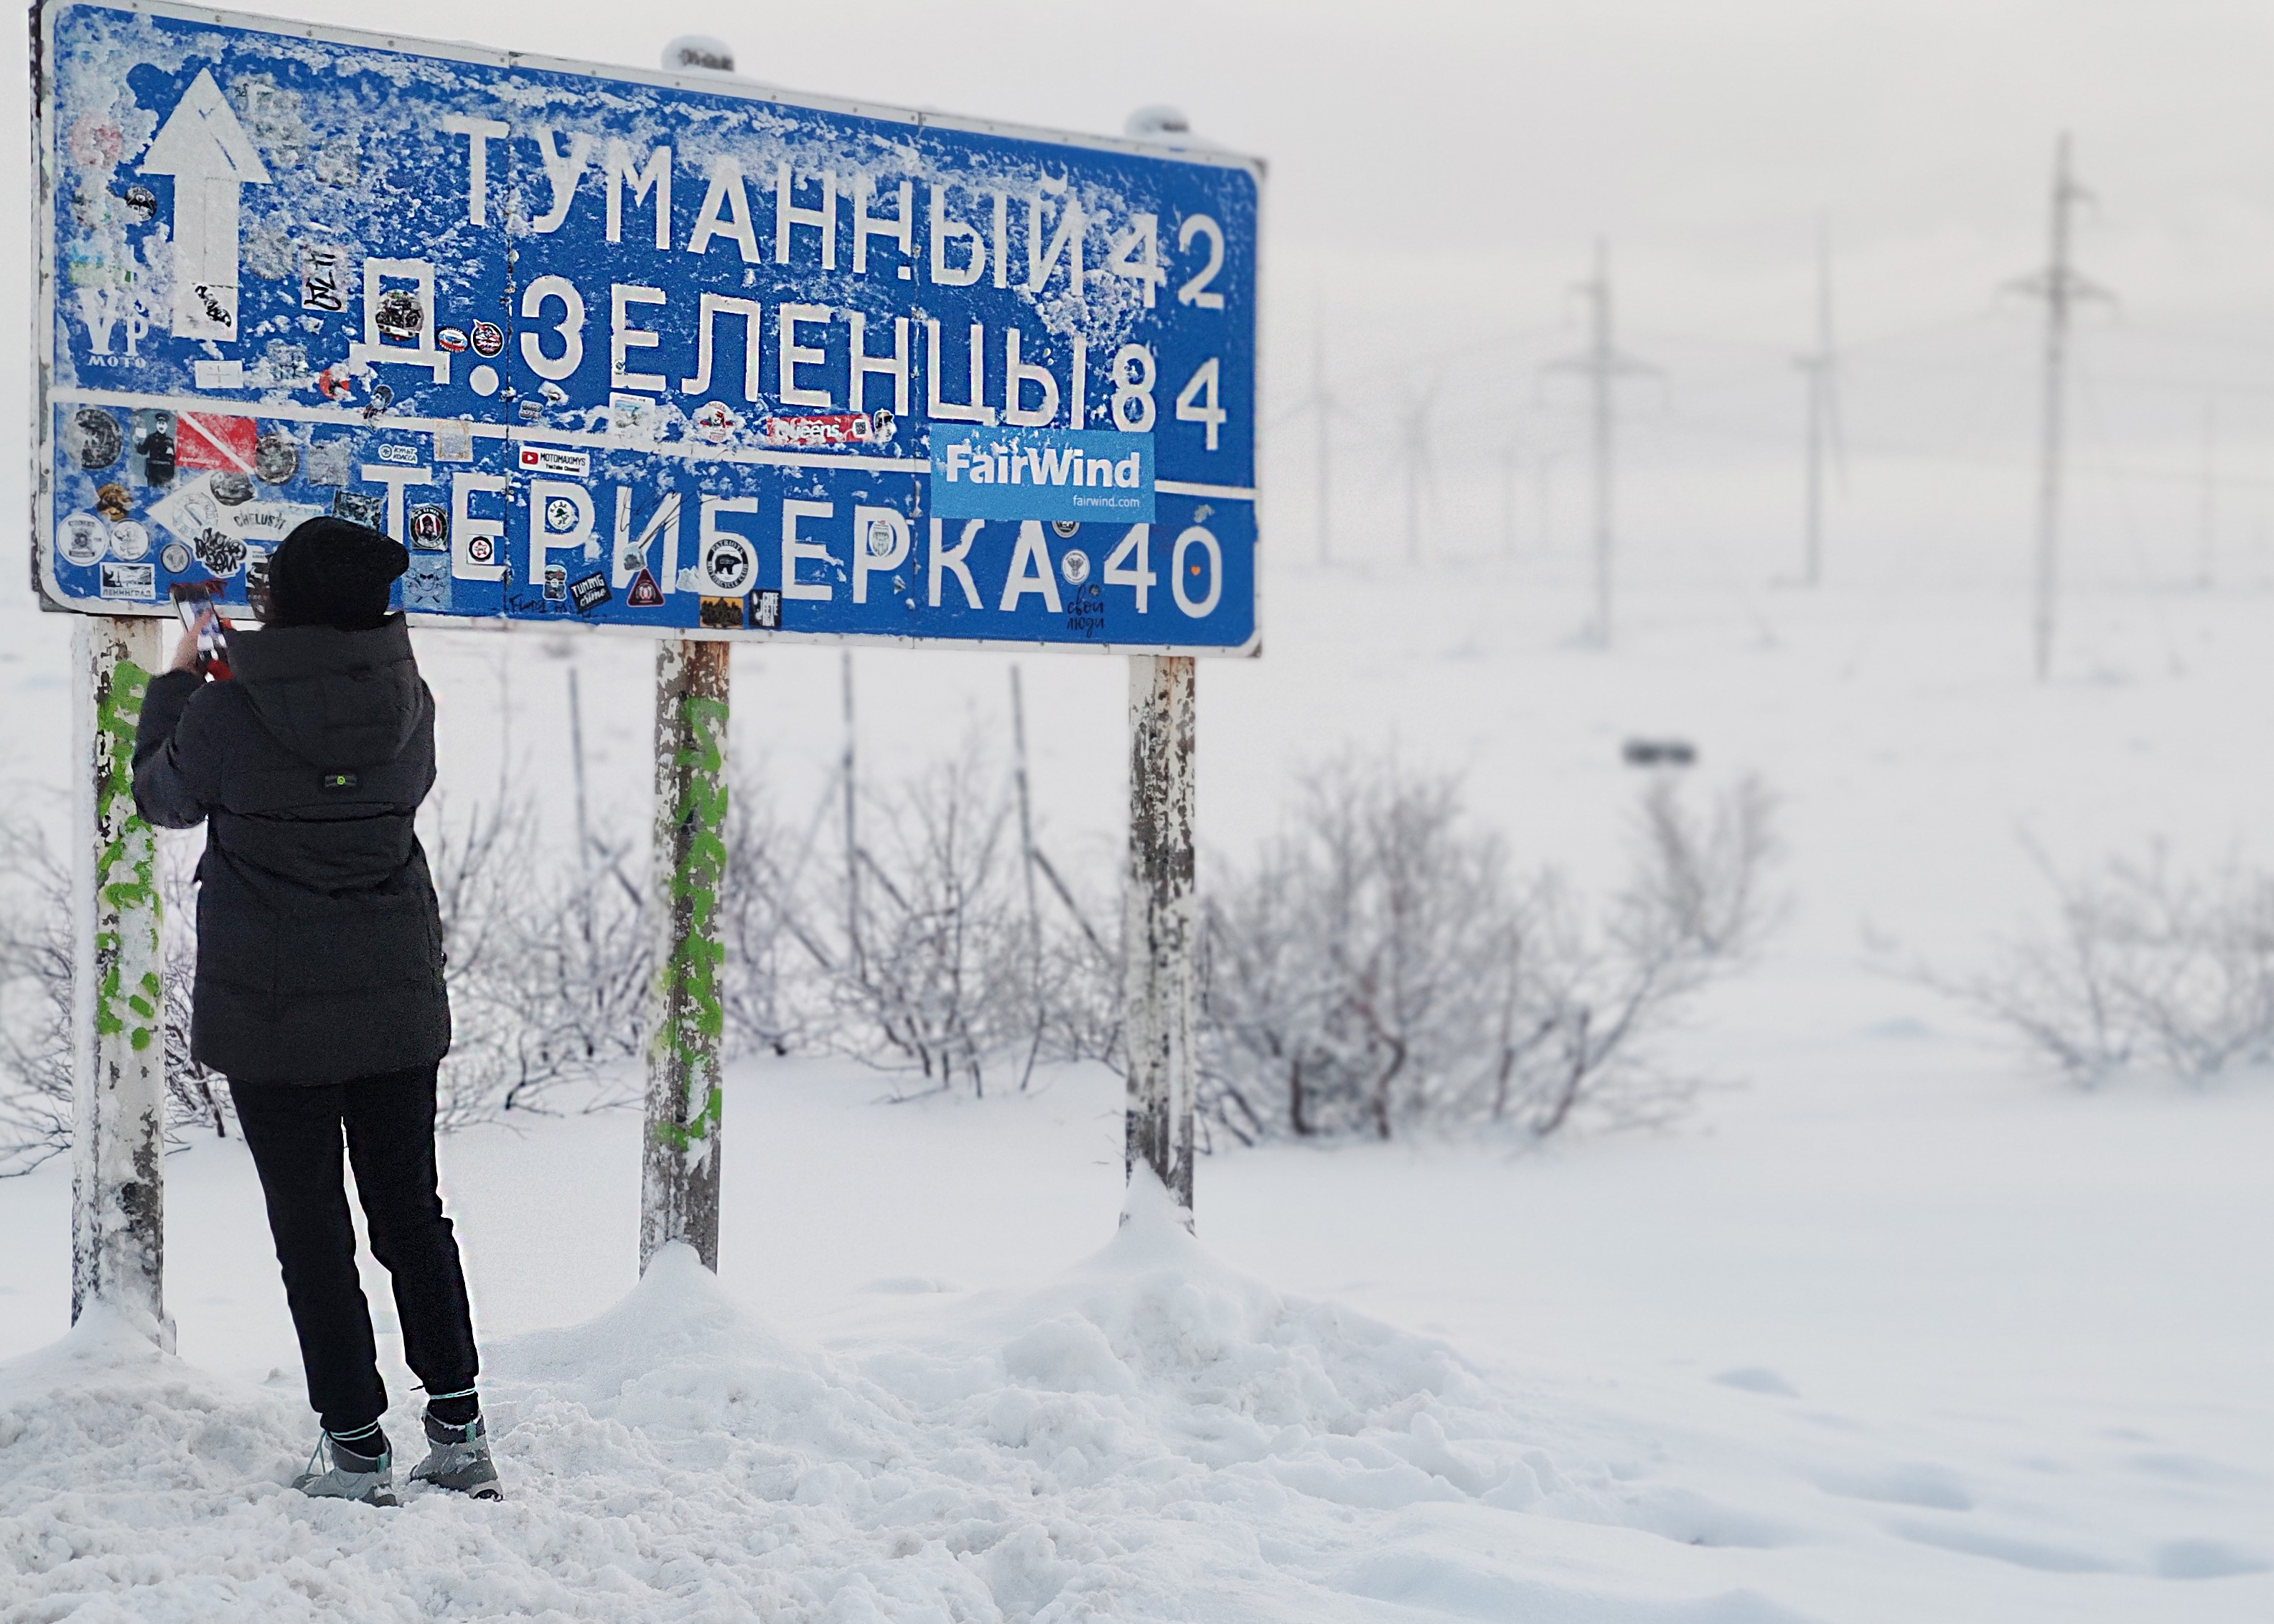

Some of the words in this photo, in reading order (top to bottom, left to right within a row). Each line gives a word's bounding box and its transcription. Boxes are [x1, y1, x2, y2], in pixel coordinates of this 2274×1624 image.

[442, 116, 1084, 296] ТУМАННЫЙ
[1110, 212, 1225, 309] 42
[1112, 344, 1227, 451] 84
[945, 443, 1141, 489] FairWind
[1072, 495, 1141, 507] fairwind.com
[361, 464, 1064, 614] ТЕРИБЕРКА
[1103, 522, 1222, 619] 40
[711, 539, 744, 555] PATRIOTS
[102, 588, 152, 597] ЛЕНИНГРАД
[706, 560, 739, 589] MOTORCYCLE
[739, 563, 749, 583] CLUB
